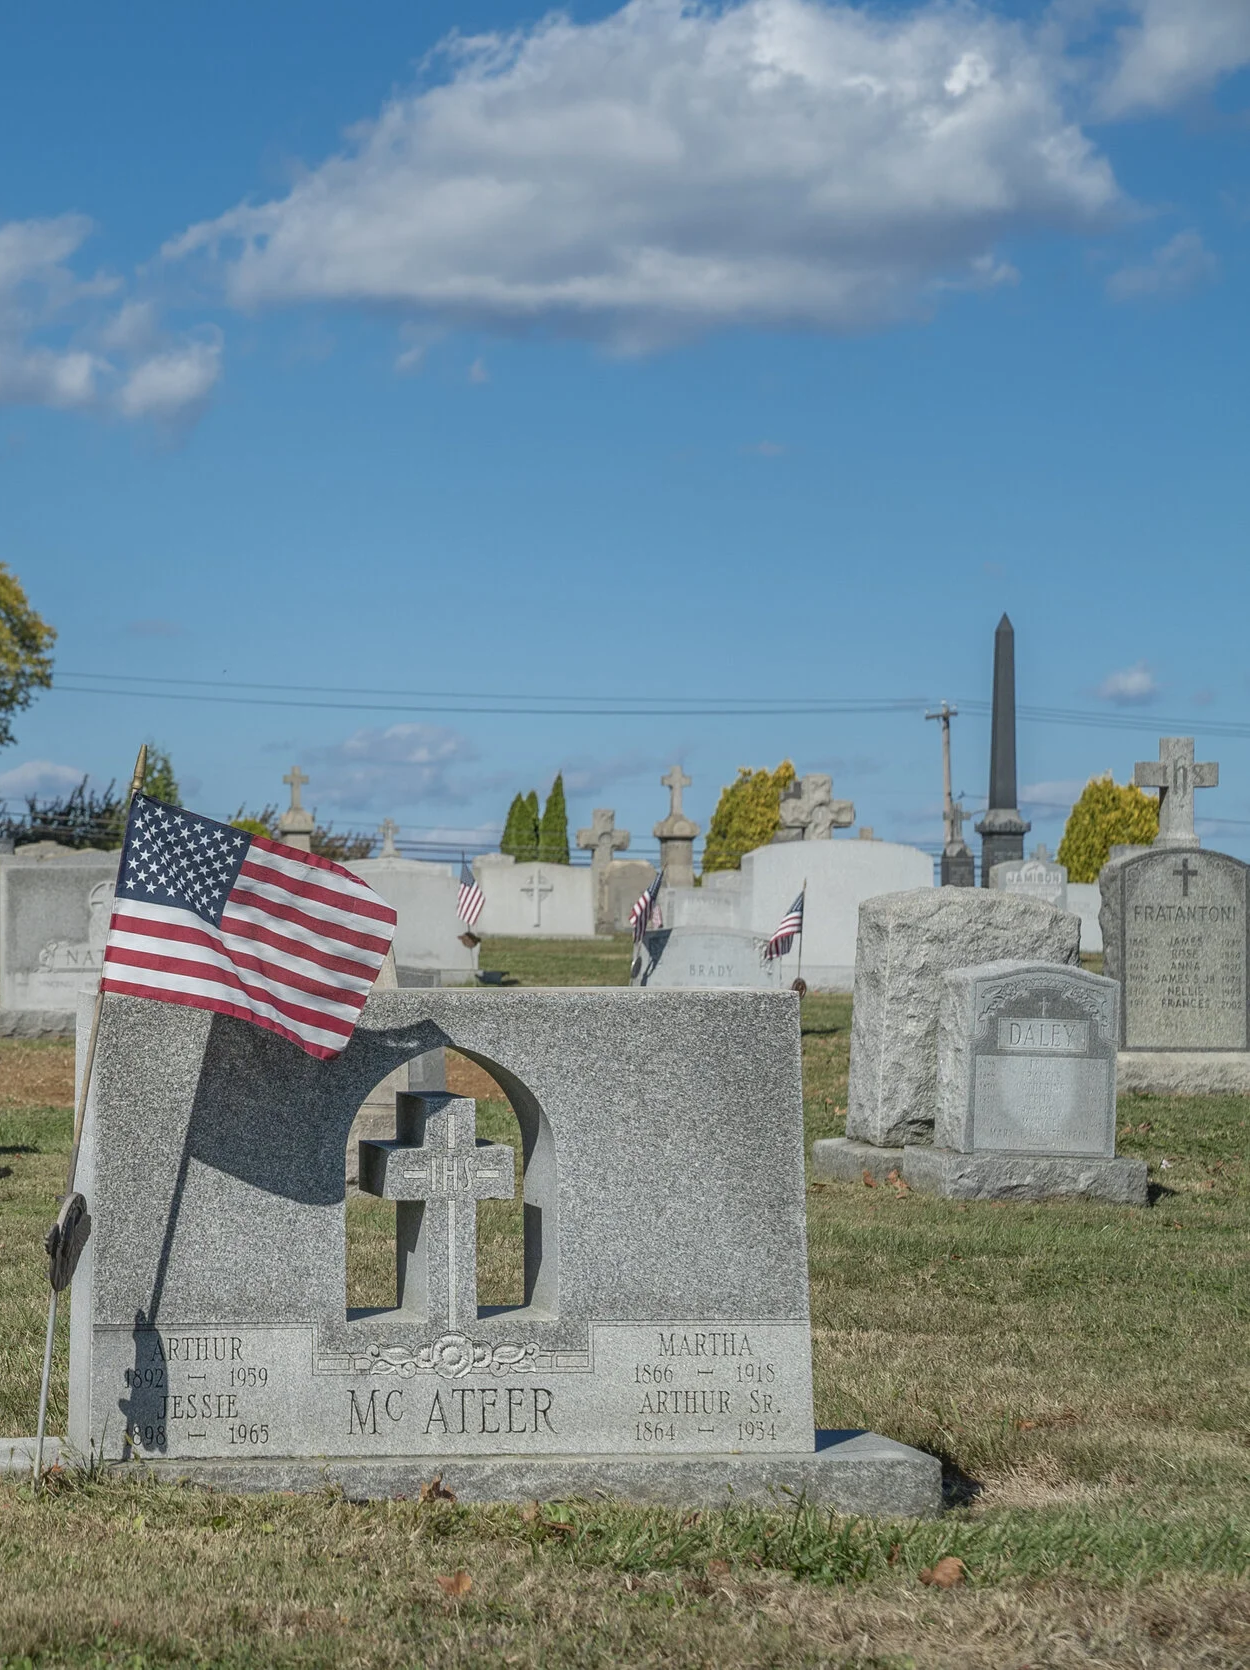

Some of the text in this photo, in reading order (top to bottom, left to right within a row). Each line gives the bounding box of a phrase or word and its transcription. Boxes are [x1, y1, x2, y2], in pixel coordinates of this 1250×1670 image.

[1134, 905, 1237, 922] FRATANTONI
[1170, 936, 1204, 948] JAMES
[1171, 948, 1199, 960] ROSE
[689, 964, 734, 978] BRADY
[1170, 960, 1201, 972] ANNA
[1154, 973, 1190, 985] JAMES
[1167, 986, 1205, 998] NELLIE
[1161, 998, 1211, 1010] FRANCES
[1009, 1022, 1077, 1047] DALEY
[431, 1155, 475, 1192] IHS
[150, 1337, 244, 1361] ARTHUR
[657, 1332, 754, 1357] MARTHA
[124, 1367, 164, 1389] 1892
[229, 1366, 268, 1388] 1959
[634, 1362, 674, 1384] 1866
[736, 1362, 776, 1383] 1918
[156, 1393, 239, 1420] JESSIE
[422, 1388, 559, 1435] ATEER
[638, 1390, 732, 1415] ARTHUR
[228, 1422, 269, 1445] 1965
[634, 1420, 676, 1442] 1864
